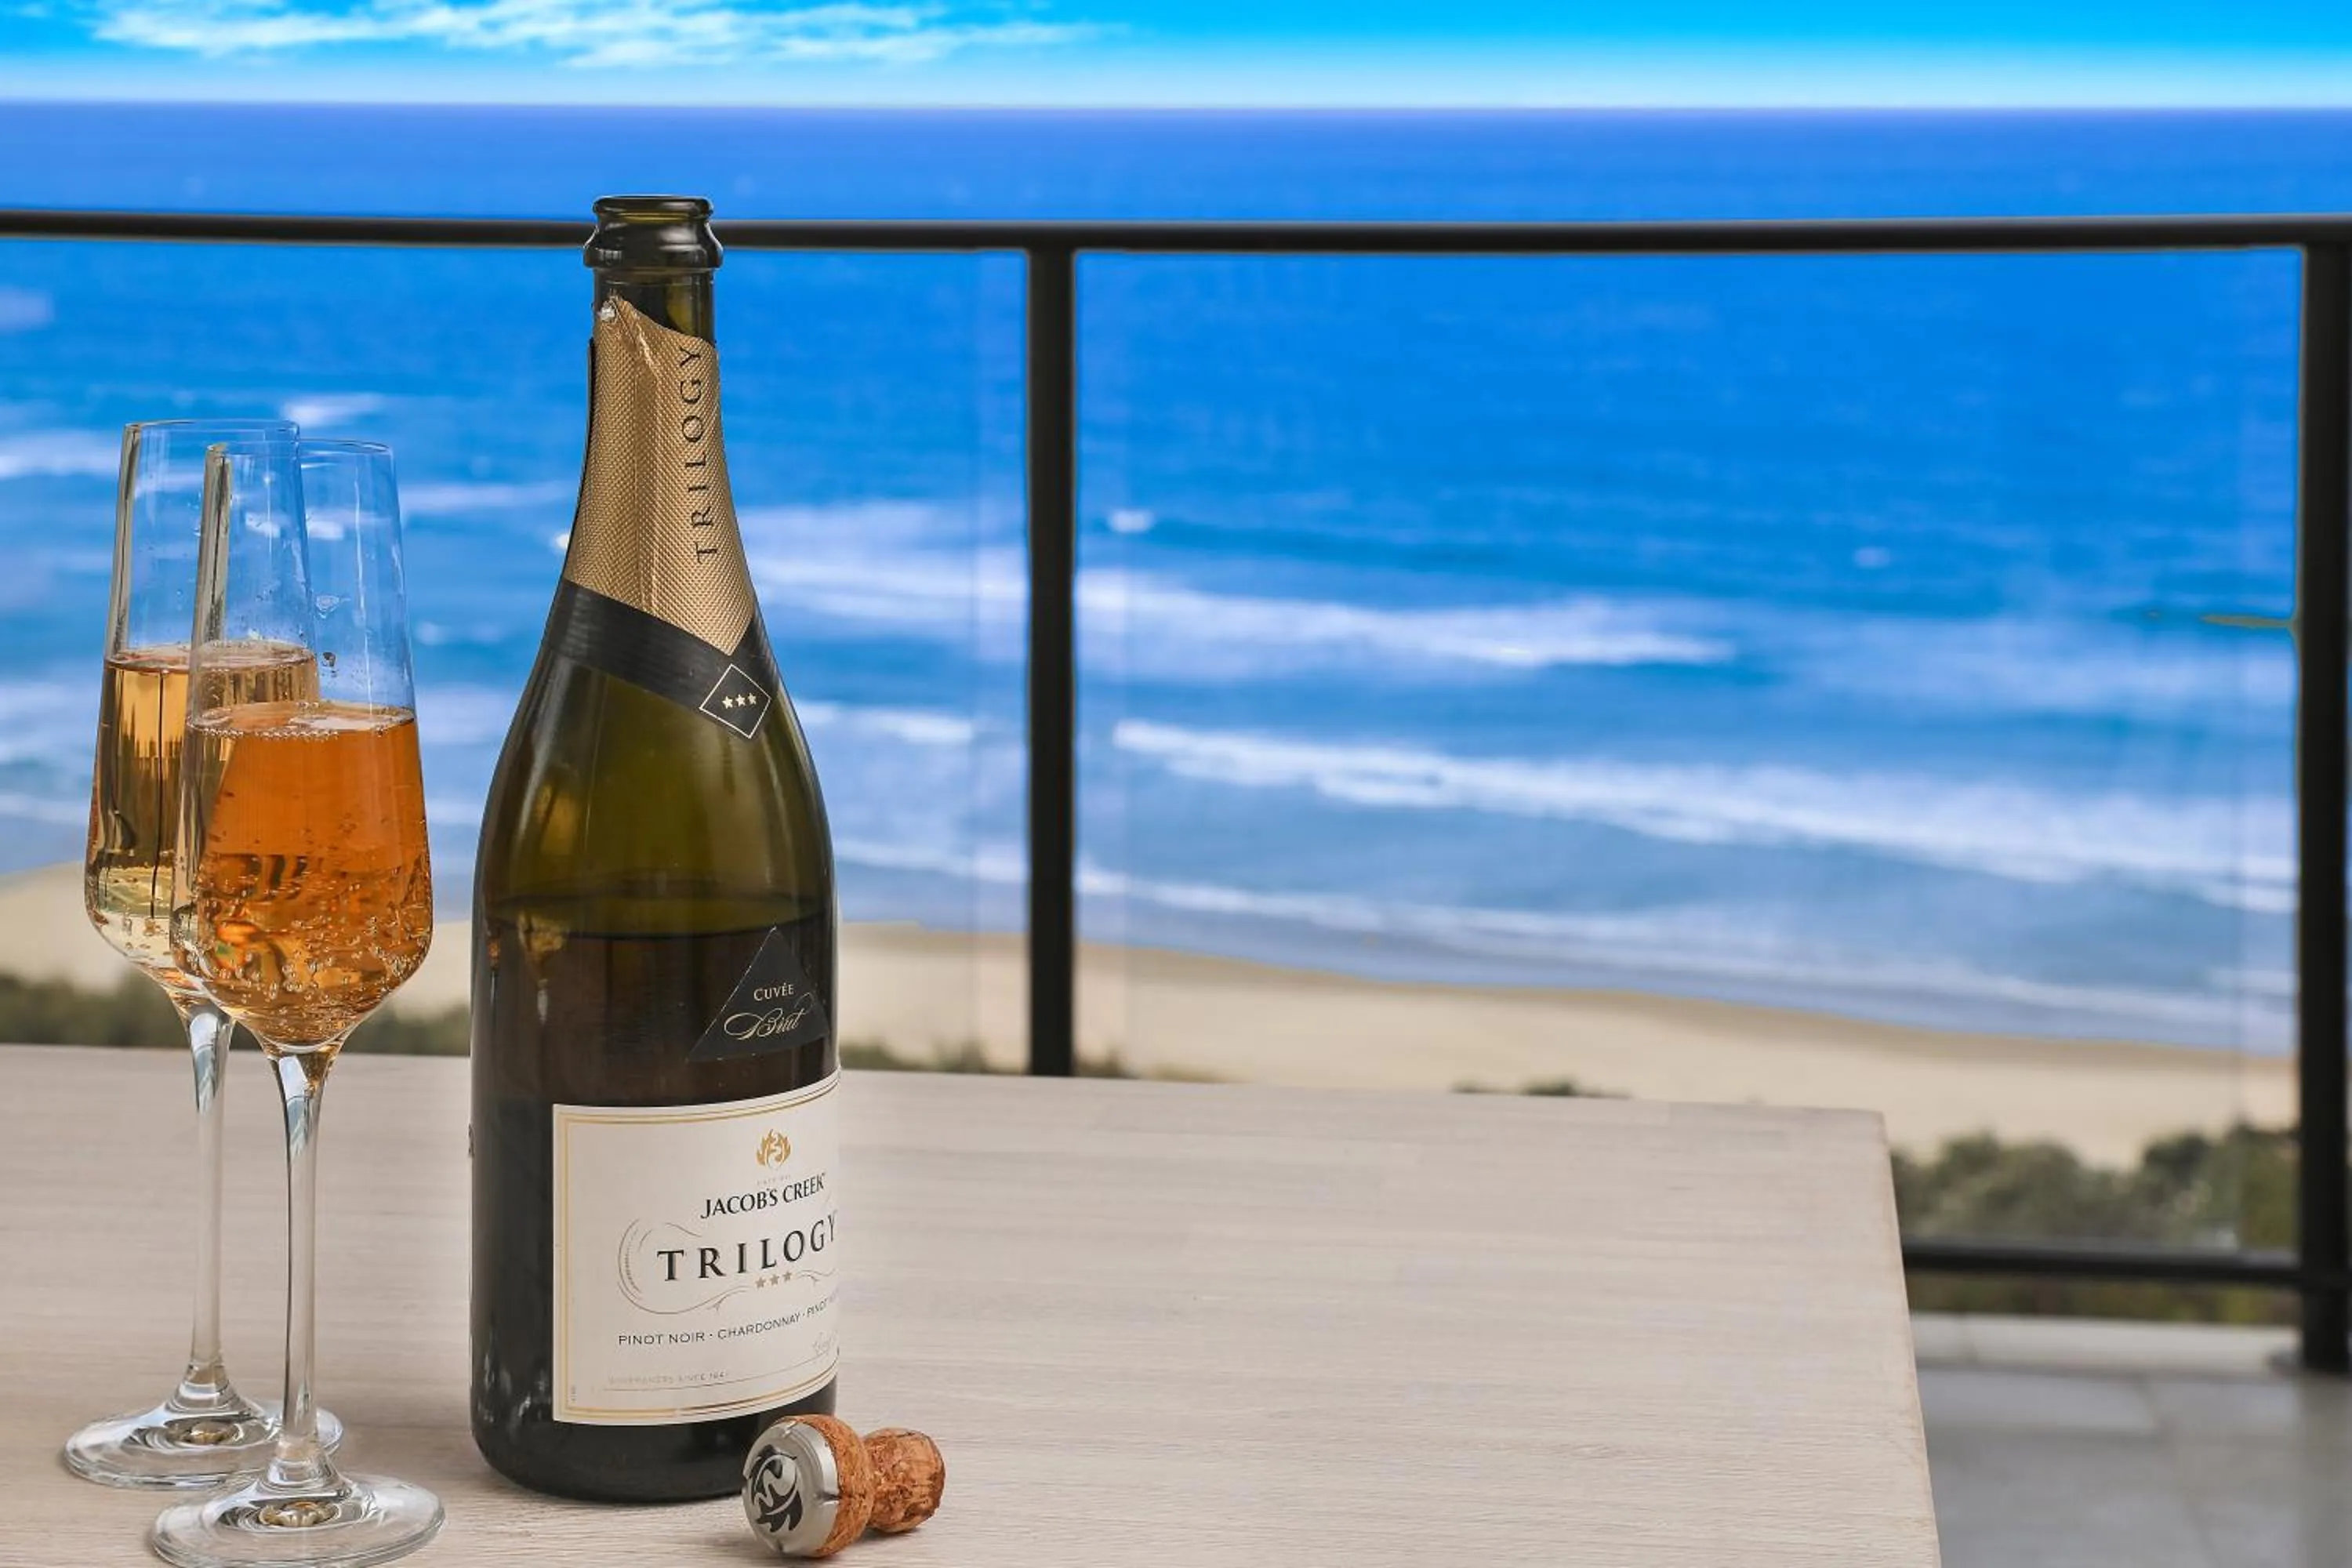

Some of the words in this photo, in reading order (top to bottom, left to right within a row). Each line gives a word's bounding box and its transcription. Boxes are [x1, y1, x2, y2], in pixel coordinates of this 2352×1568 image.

[679, 346, 718, 564] TRILOGY
[753, 982, 794, 1001] CUVÉE
[724, 992, 815, 1040] Brut
[700, 1187, 779, 1220] JACOB'S
[782, 1173, 826, 1204] CREEK
[656, 1212, 837, 1282] TRILOGY
[618, 1333, 664, 1346] PINOT
[669, 1331, 706, 1344] NOIR
[717, 1312, 800, 1340] CHARDONNAY
